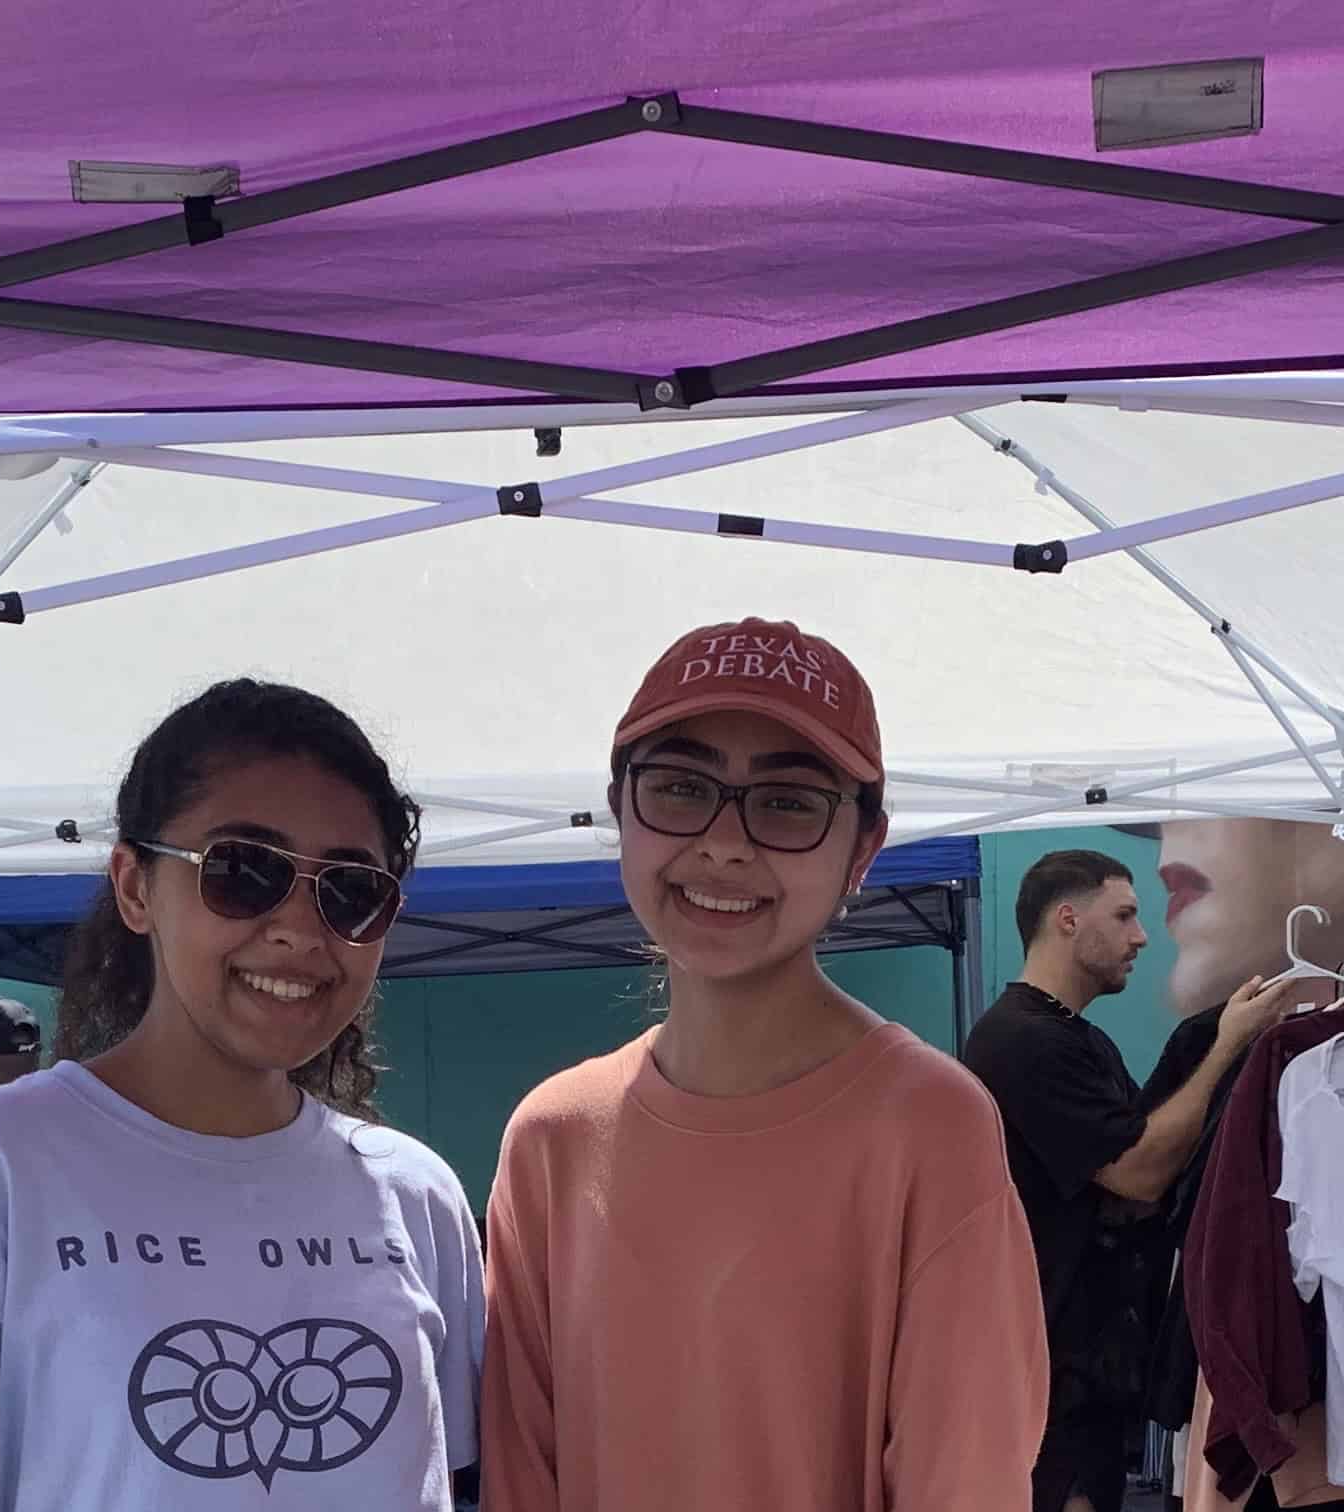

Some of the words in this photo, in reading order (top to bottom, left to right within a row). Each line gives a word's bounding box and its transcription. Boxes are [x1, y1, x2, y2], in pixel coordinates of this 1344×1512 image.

[702, 634, 822, 672] TEXAS
[679, 654, 839, 710] DEBATE
[57, 1231, 206, 1271] RICE
[259, 1236, 407, 1268] OWLS
